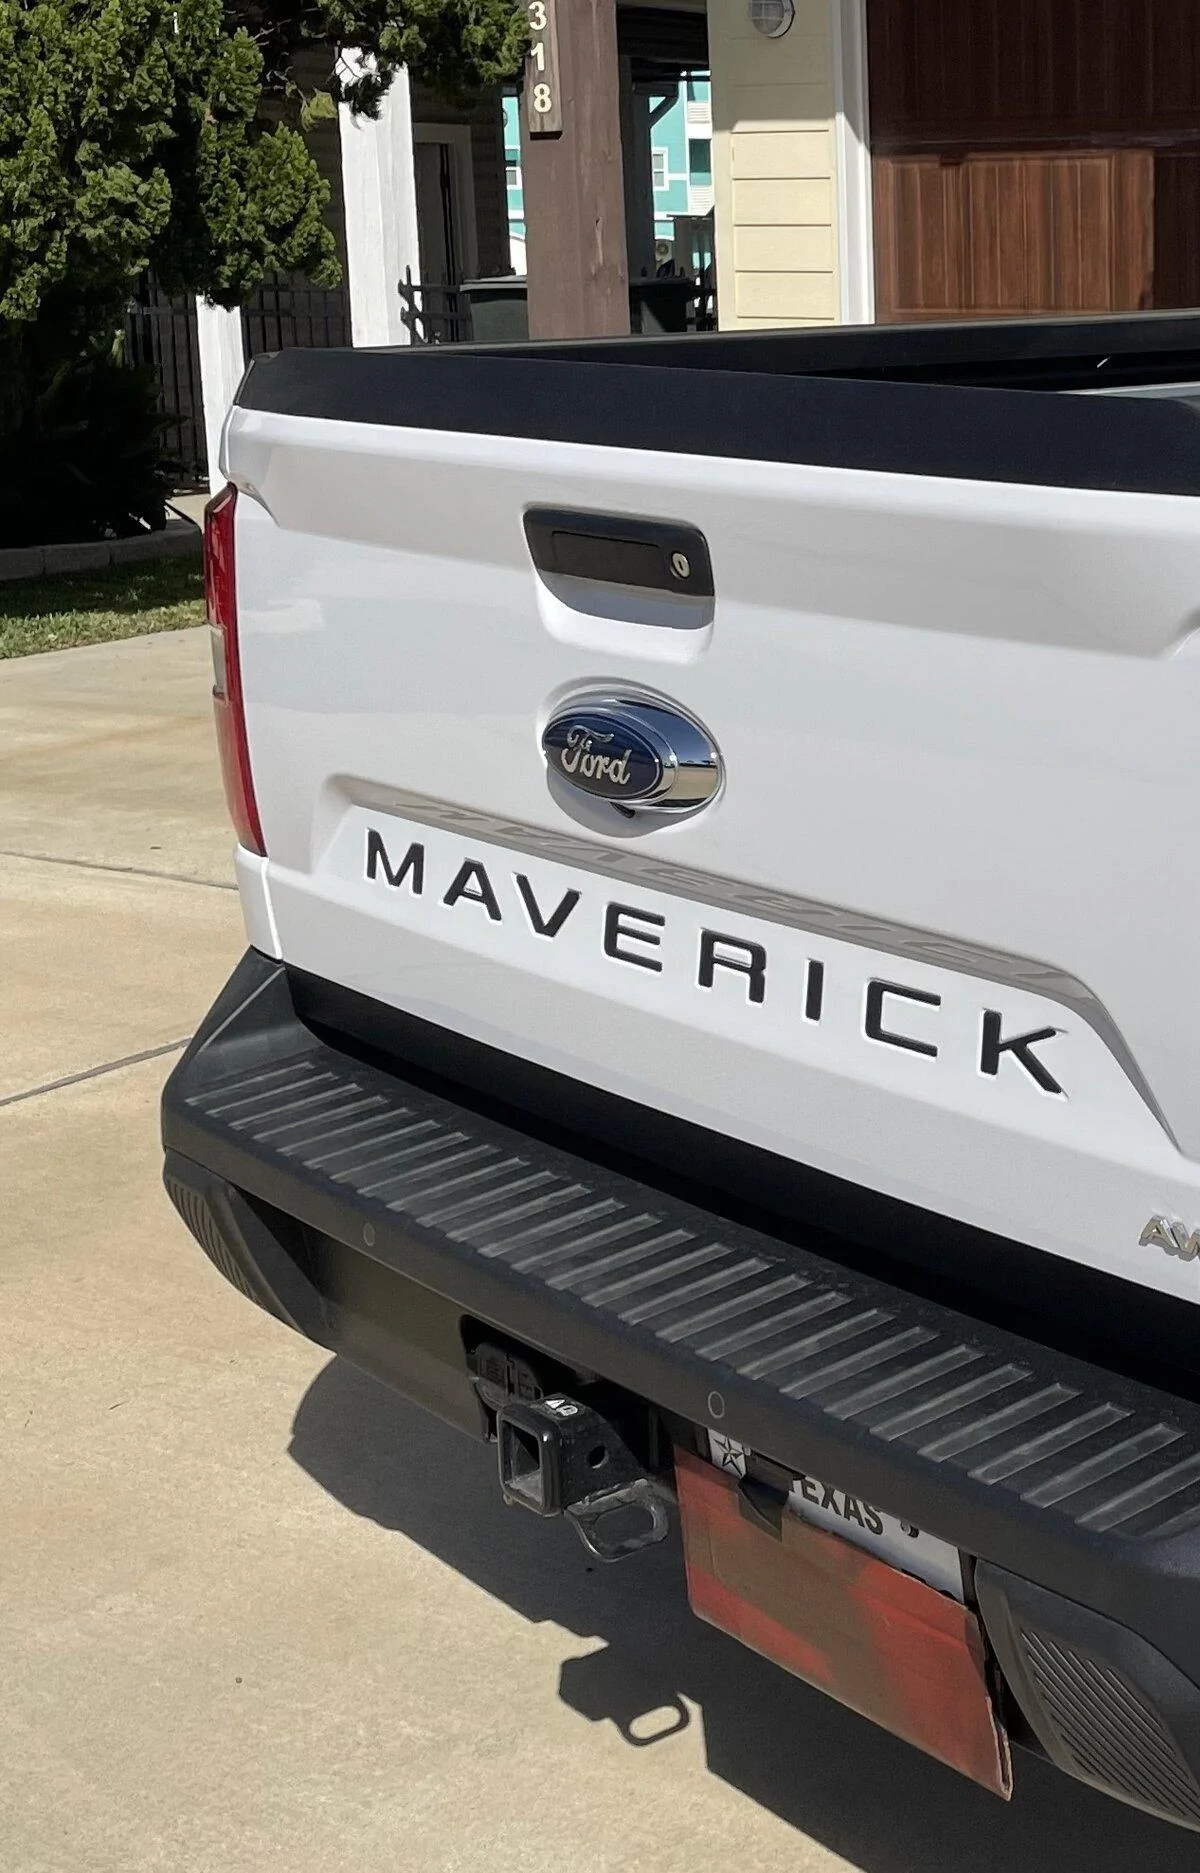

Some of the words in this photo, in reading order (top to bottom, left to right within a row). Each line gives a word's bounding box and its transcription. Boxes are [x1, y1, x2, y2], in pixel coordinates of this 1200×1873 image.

[528, 1, 552, 112] 318
[561, 725, 632, 785] Ford
[364, 828, 1067, 1098] MAVERICK
